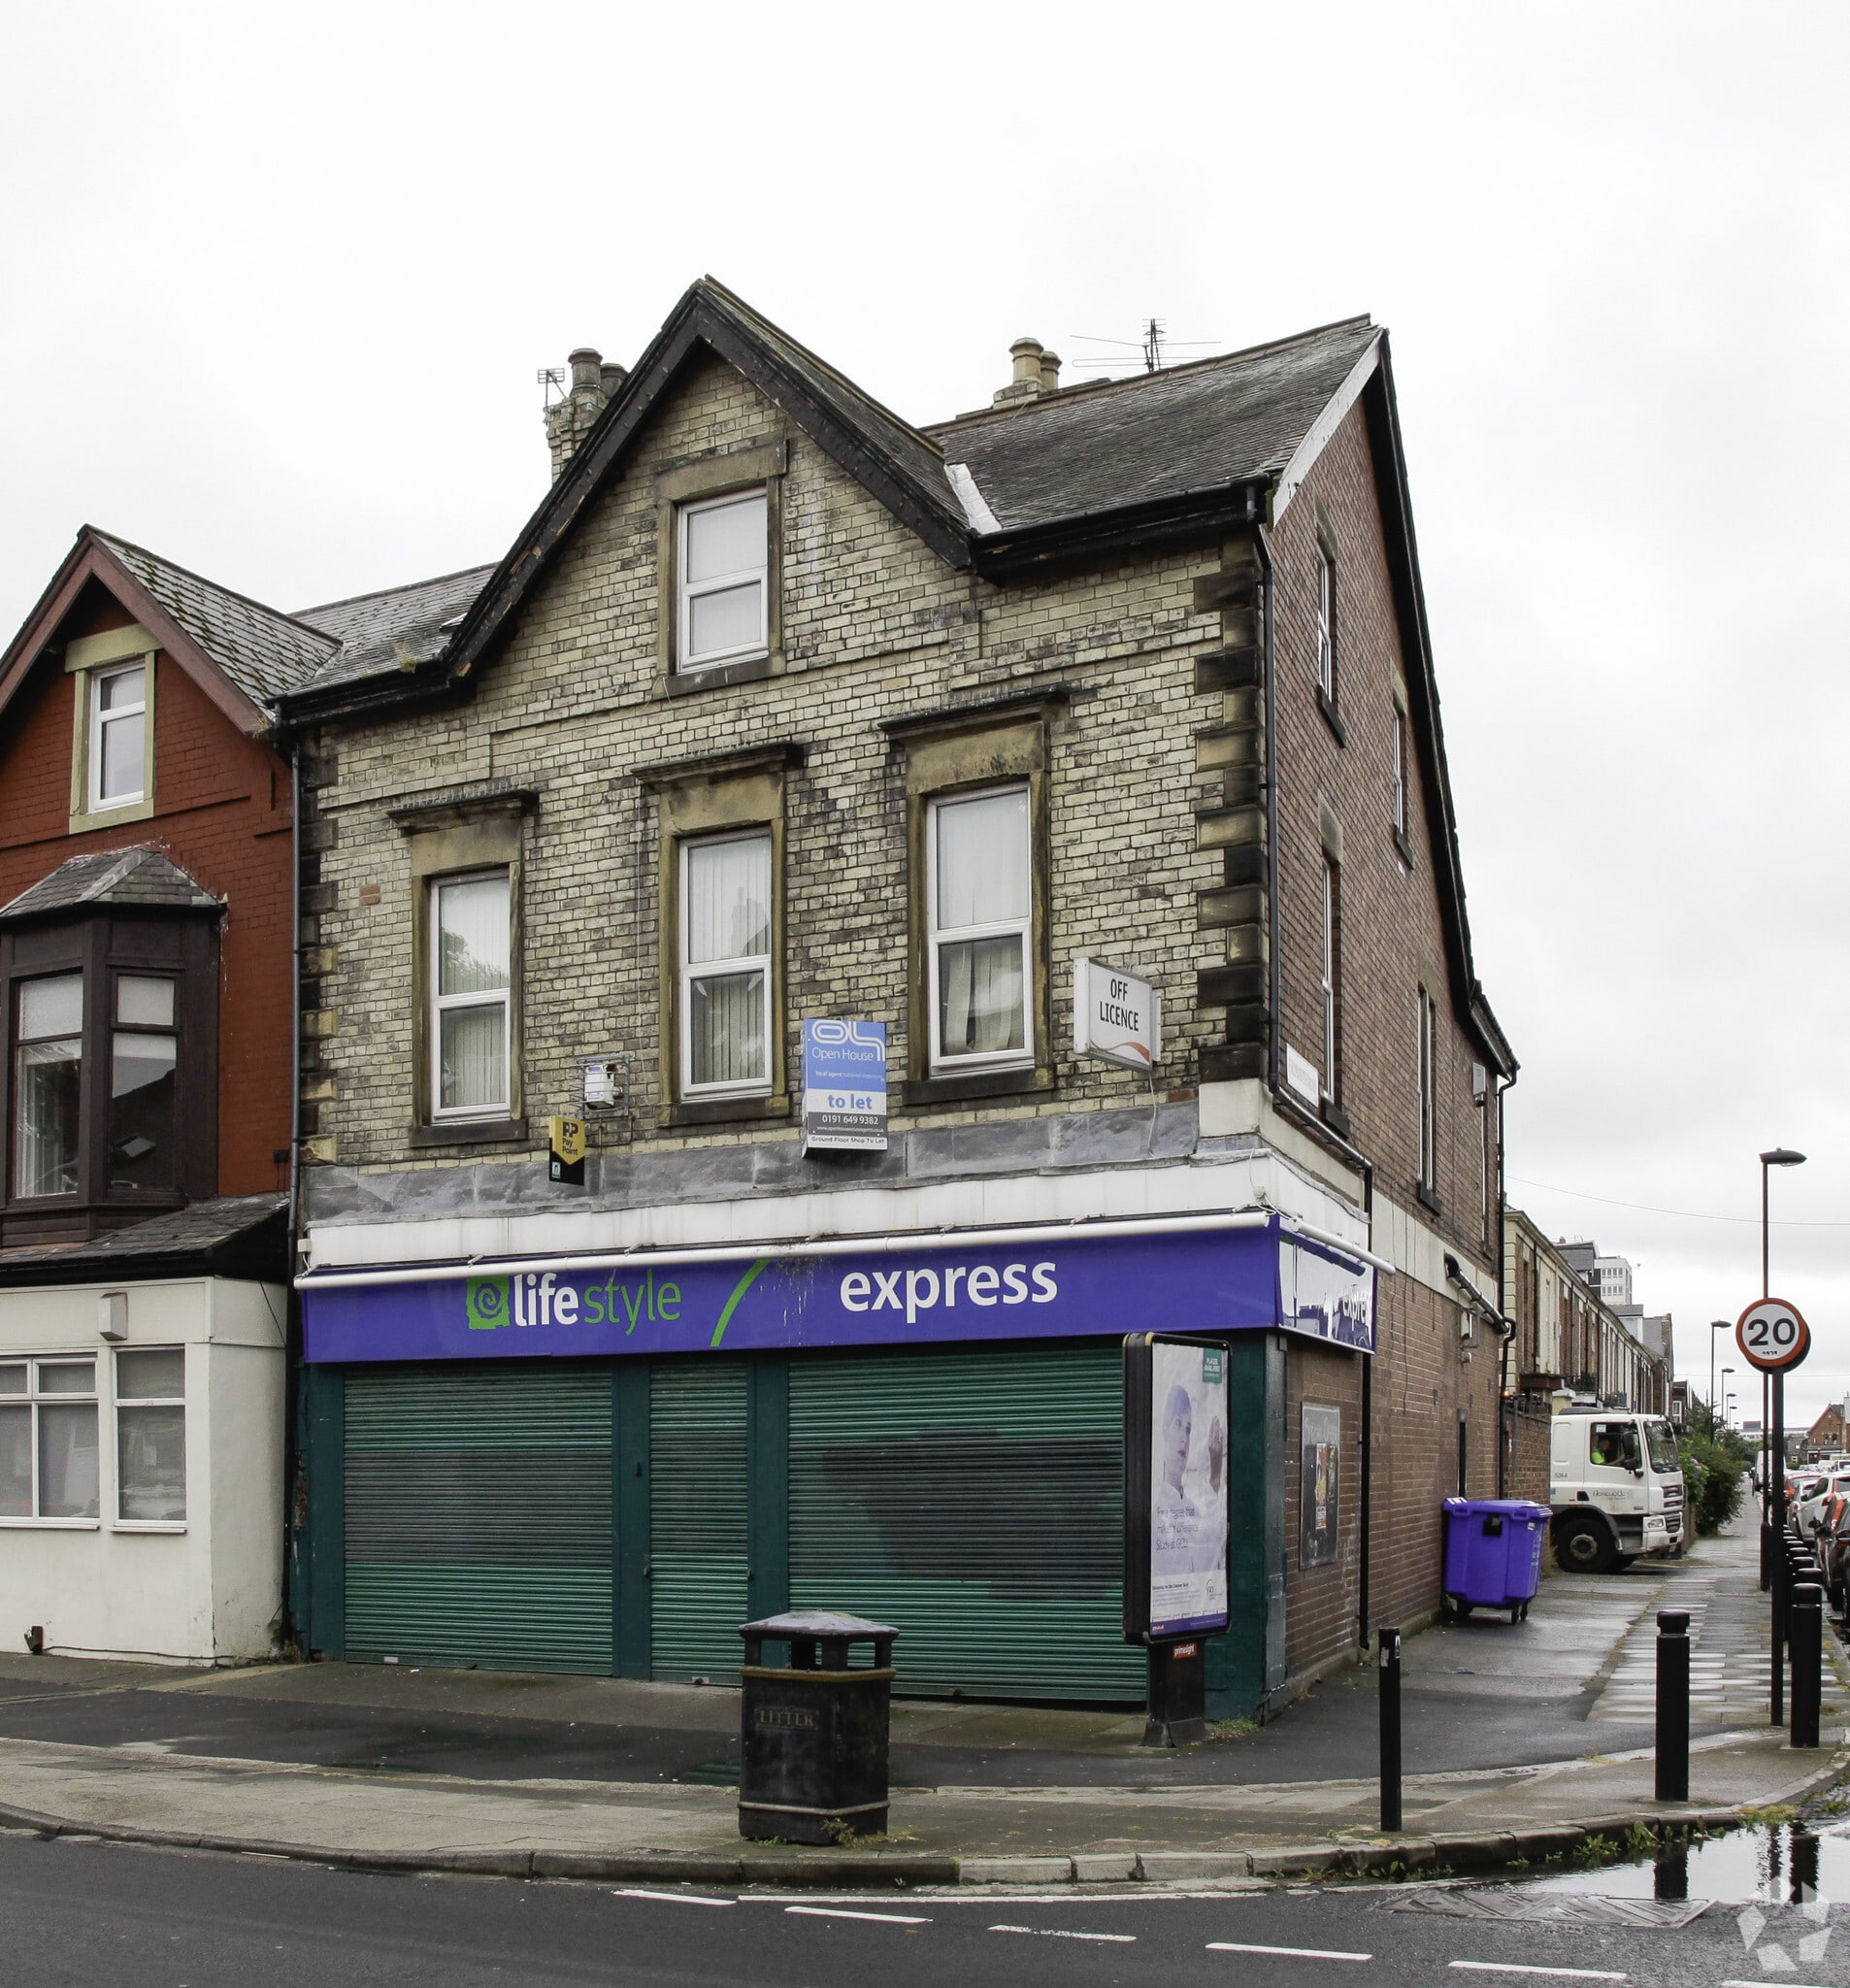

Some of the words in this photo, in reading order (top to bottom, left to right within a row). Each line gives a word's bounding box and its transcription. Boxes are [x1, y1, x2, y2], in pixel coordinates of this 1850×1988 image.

[1110, 978, 1128, 1002] OFF
[1100, 1001, 1139, 1032] LICENCE
[811, 1046, 841, 1061] Open
[842, 1048, 875, 1061] House
[827, 1095, 845, 1109] to
[850, 1093, 873, 1110] let
[821, 1114, 841, 1123] 0191
[842, 1115, 858, 1124] 649
[859, 1116, 878, 1125] 9382
[562, 1138, 573, 1148] Pay
[841, 1262, 1058, 1323] express
[1748, 1318, 1795, 1346] 20
[760, 1709, 814, 1727] LITTER
